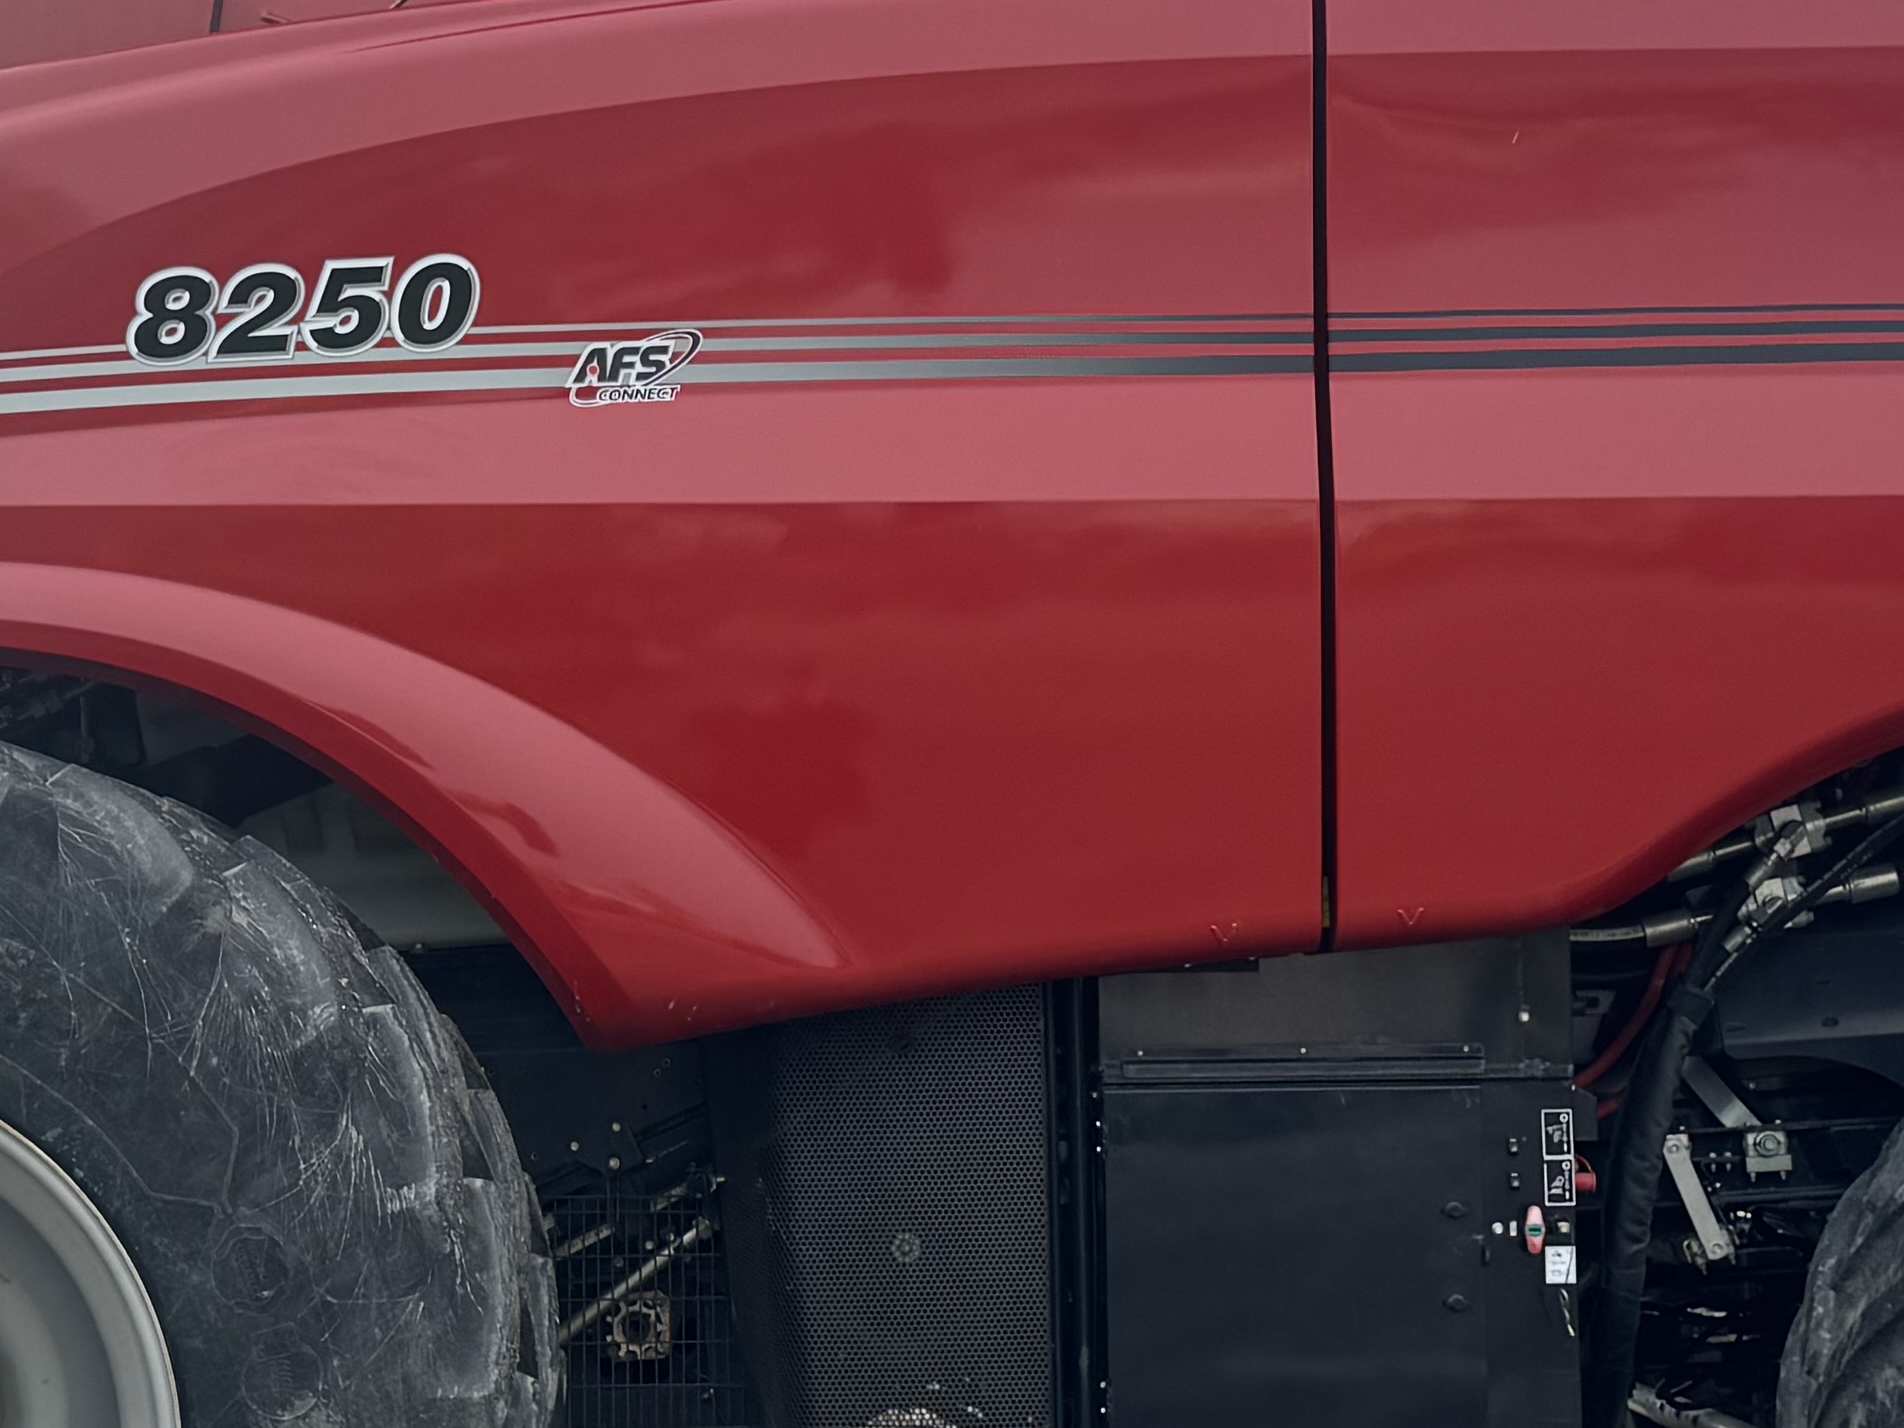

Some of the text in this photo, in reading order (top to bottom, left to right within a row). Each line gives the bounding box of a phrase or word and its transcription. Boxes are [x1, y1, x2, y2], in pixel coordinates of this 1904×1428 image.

[126, 253, 480, 366] 8250
[566, 340, 676, 388] AFS
[596, 384, 681, 403] CONNECT
